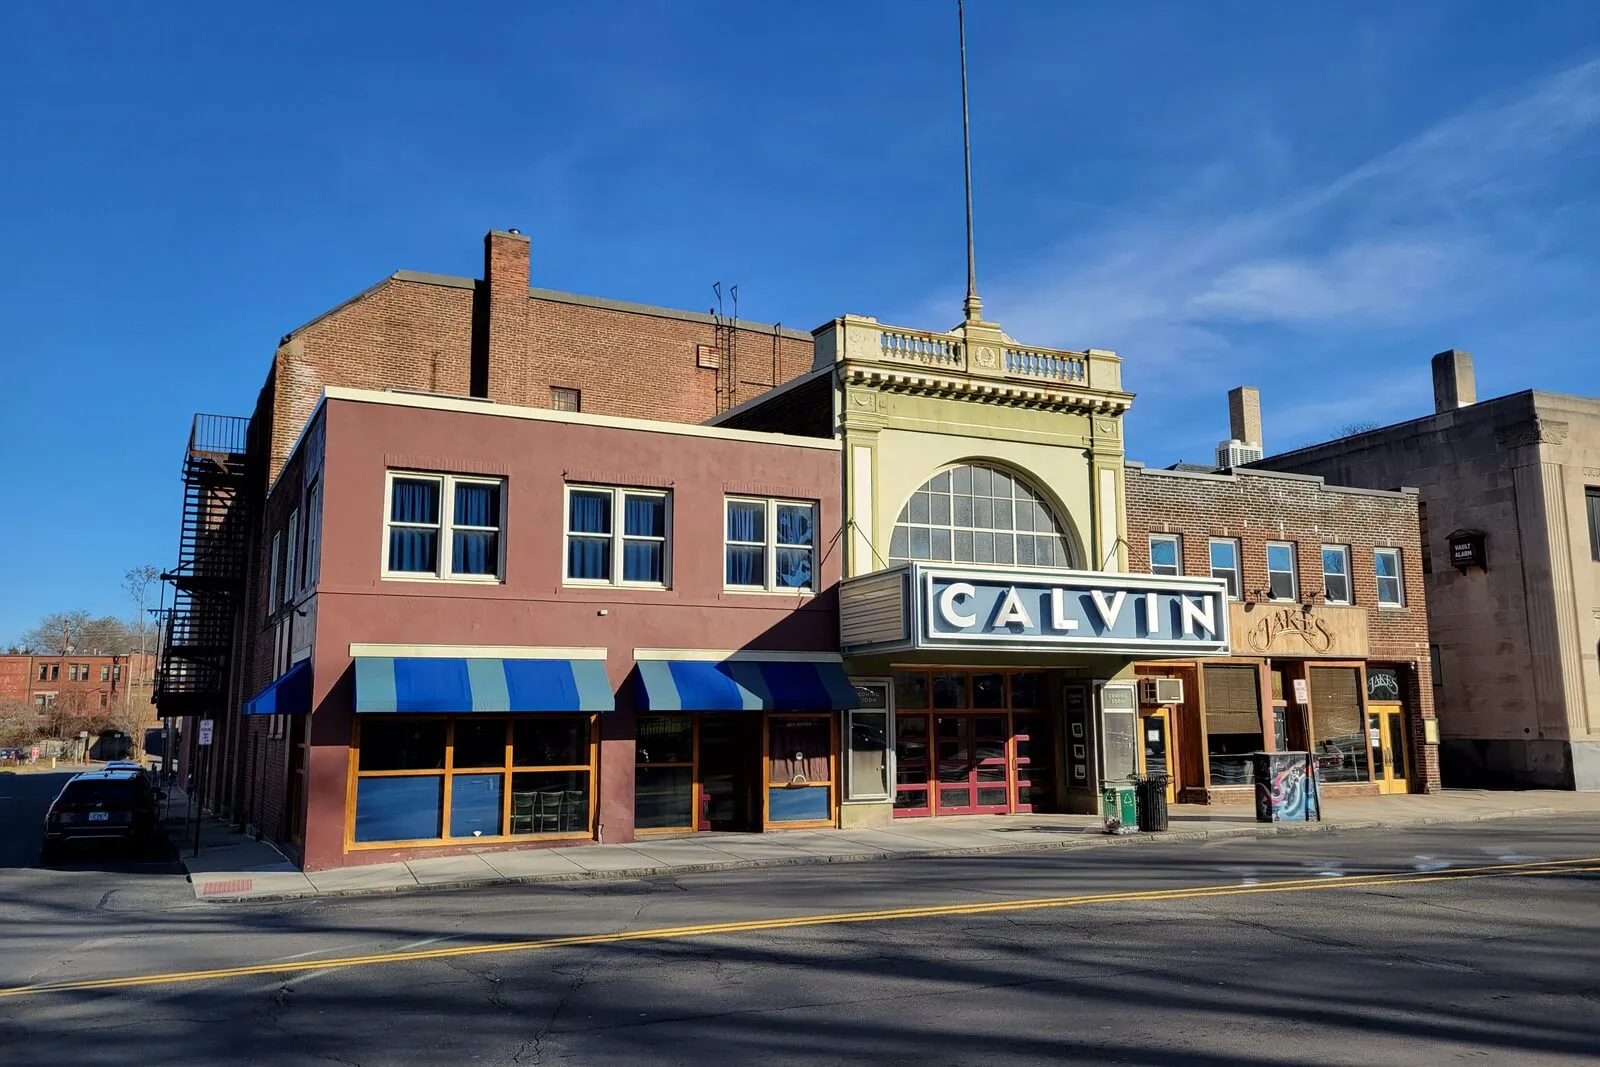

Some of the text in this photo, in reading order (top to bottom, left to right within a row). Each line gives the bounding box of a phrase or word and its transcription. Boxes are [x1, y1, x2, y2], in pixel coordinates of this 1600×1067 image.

[1454, 543, 1471, 551] VAULT
[1455, 550, 1472, 558] ALARM
[939, 582, 1216, 637] CALVIN
[1367, 673, 1399, 695] JAKES
